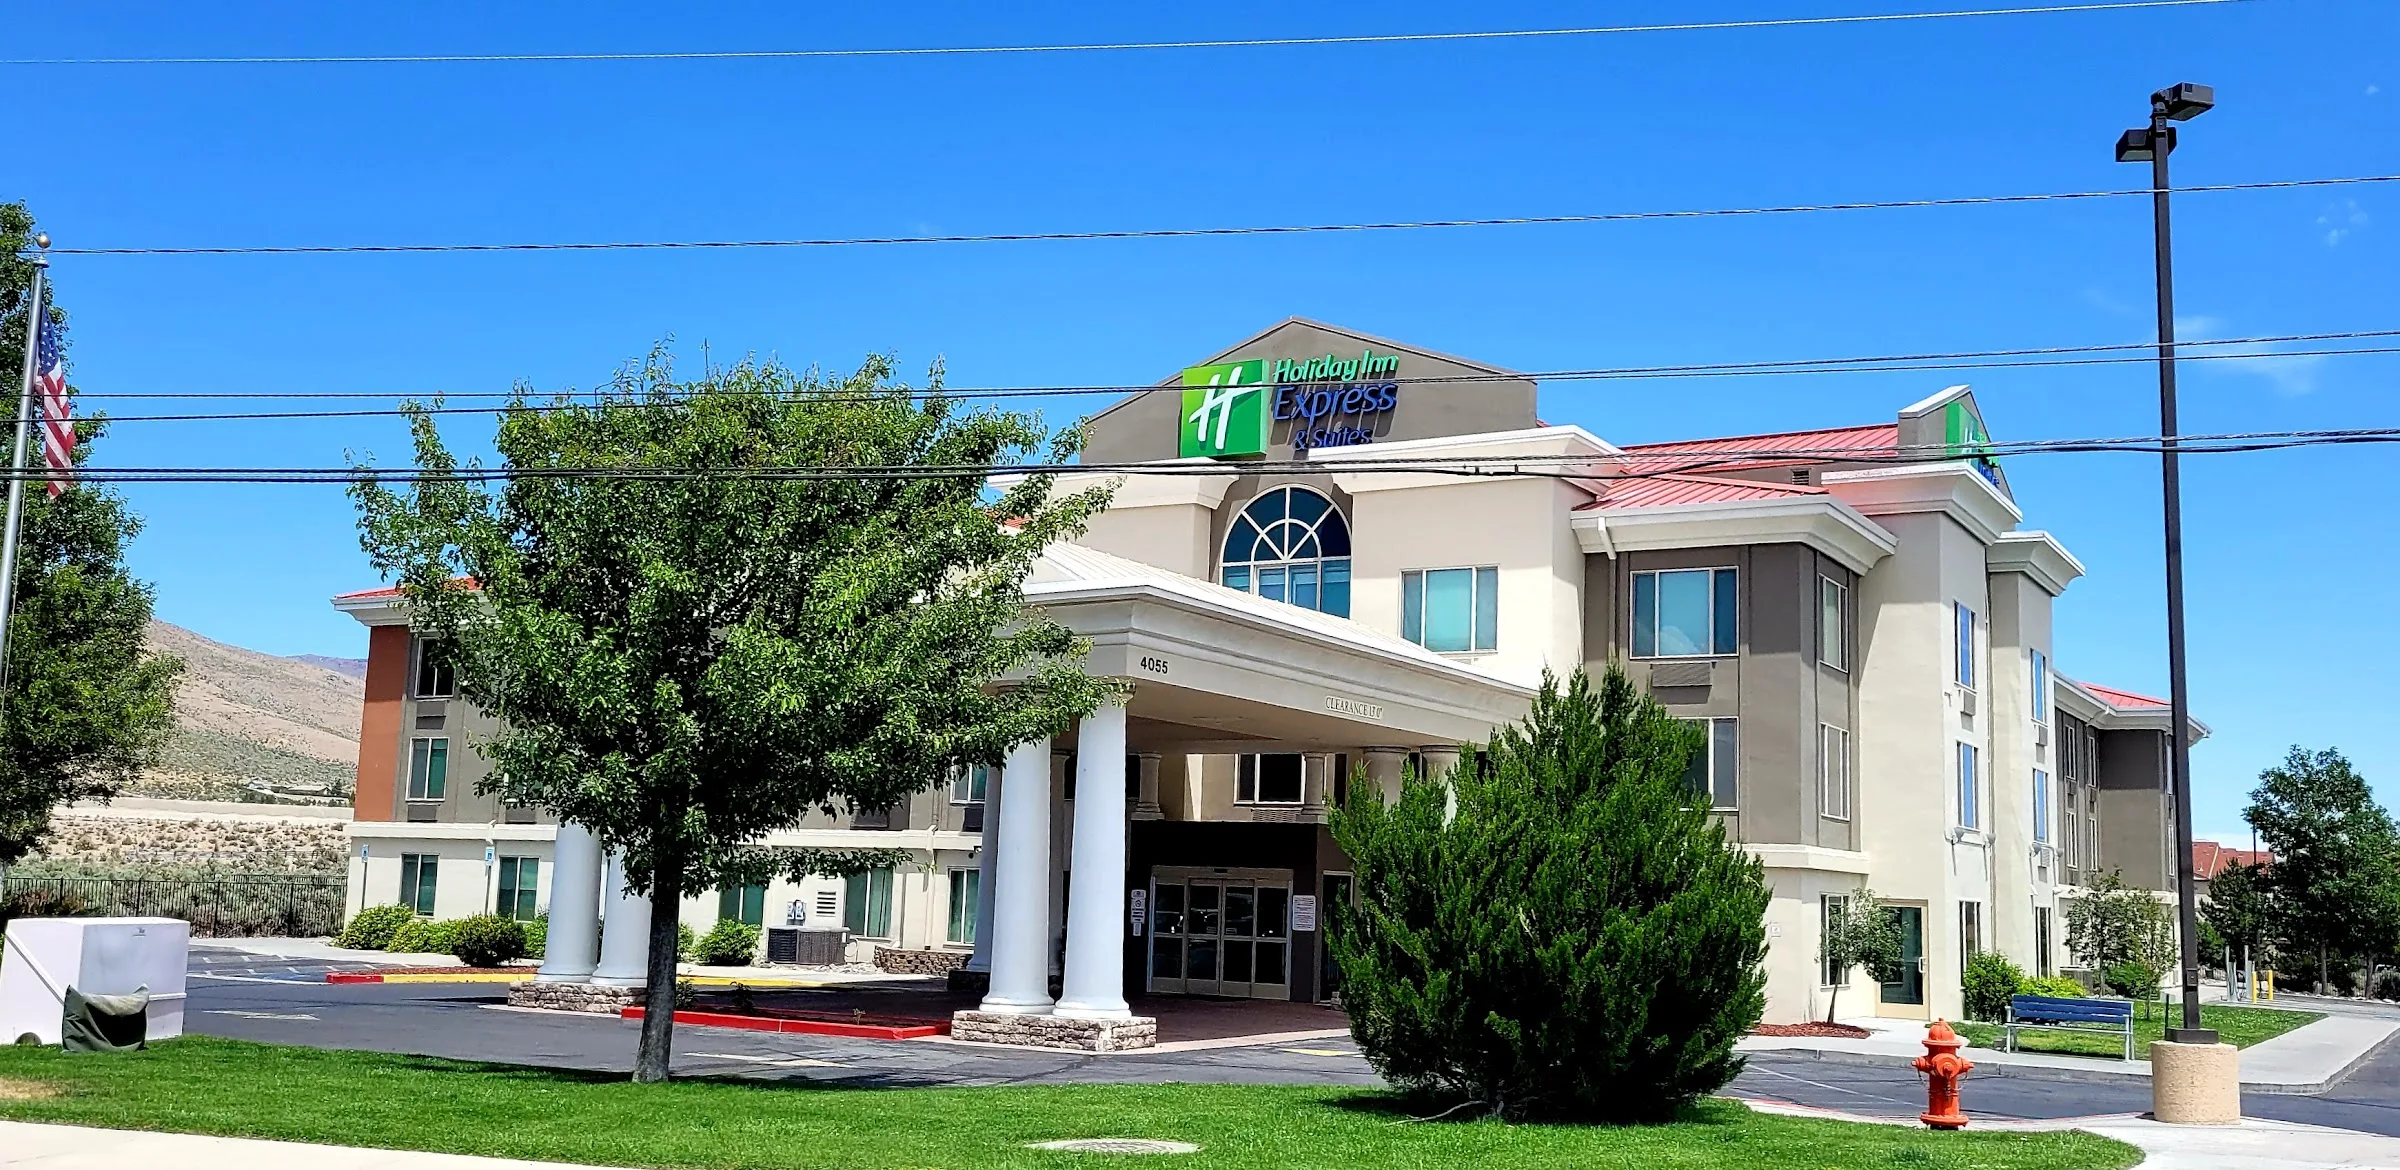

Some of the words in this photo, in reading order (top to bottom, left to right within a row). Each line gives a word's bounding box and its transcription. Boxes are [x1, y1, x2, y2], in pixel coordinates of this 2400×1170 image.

[1272, 354, 1360, 383] Holiday
[1361, 349, 1398, 374] Inn
[1272, 383, 1397, 427] Express
[1292, 429, 1308, 450] &
[1312, 427, 1373, 448] Suites
[1140, 656, 1168, 674] 4055
[1325, 697, 1368, 716] CLEARANCE
